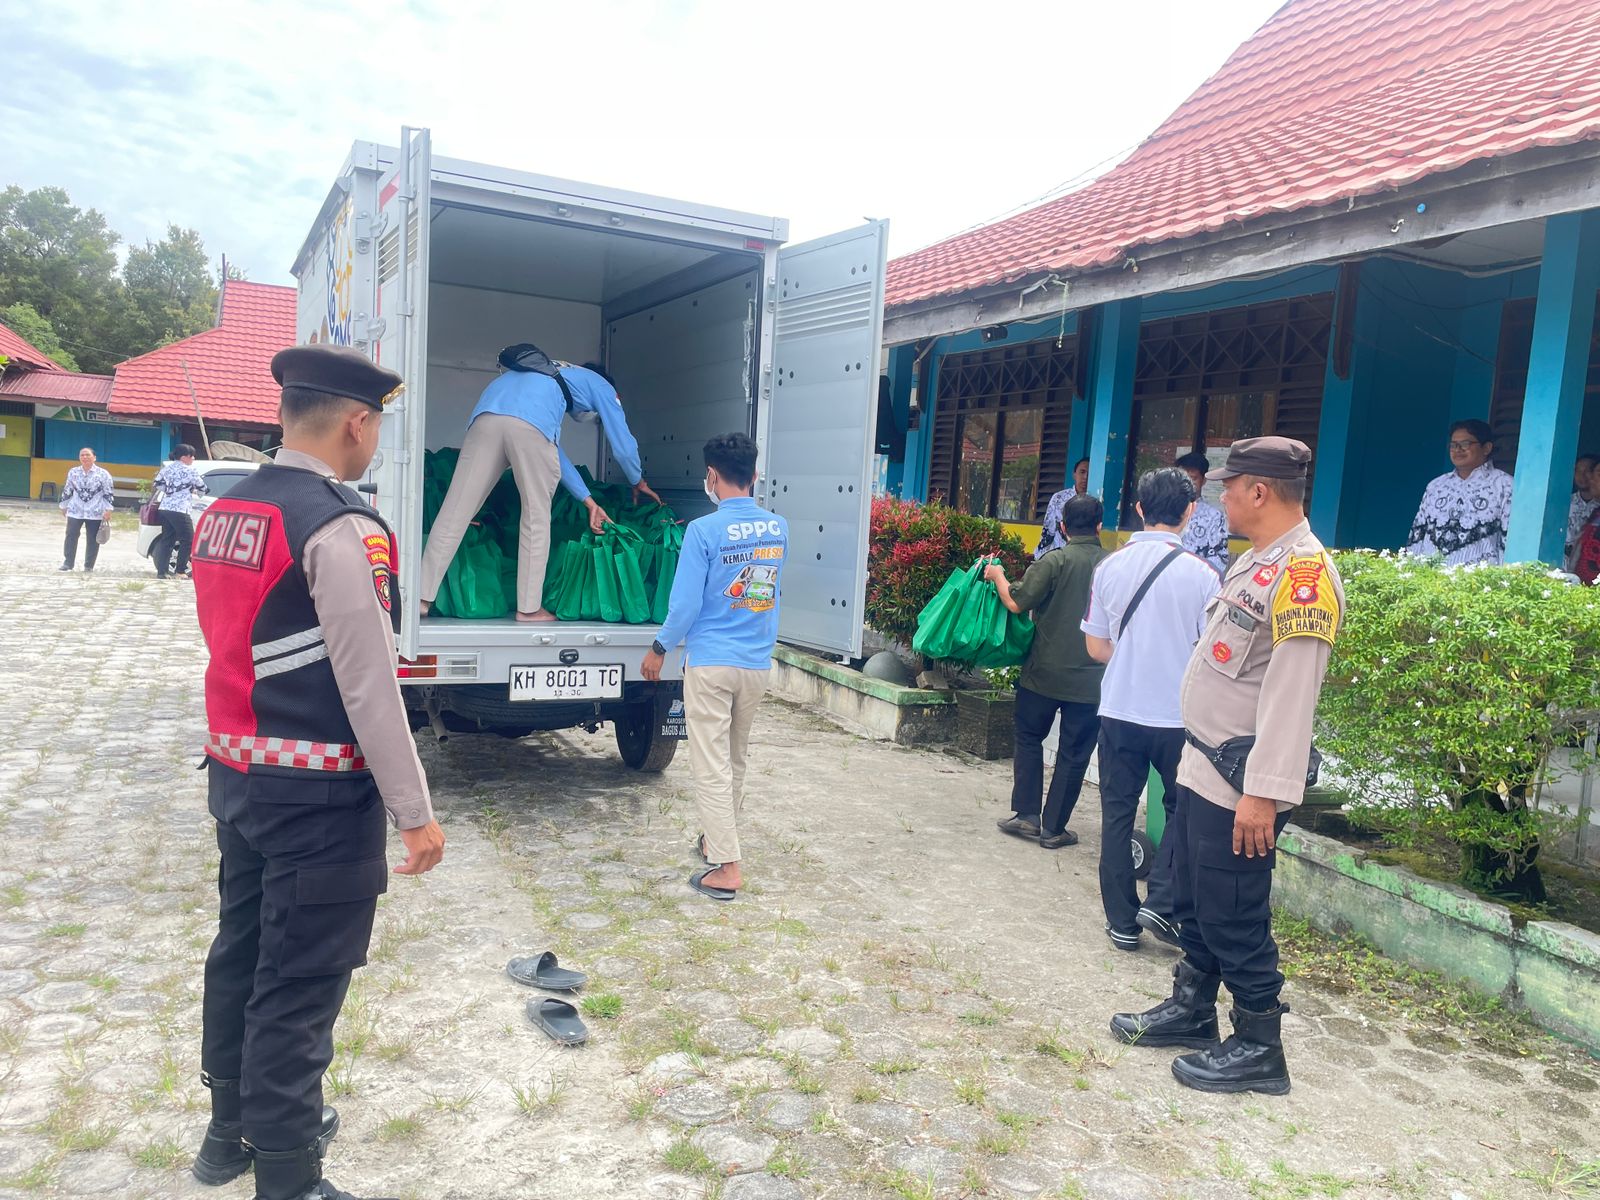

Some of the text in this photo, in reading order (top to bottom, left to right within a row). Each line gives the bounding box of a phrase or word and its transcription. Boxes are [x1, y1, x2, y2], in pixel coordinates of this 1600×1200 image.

[195, 514, 266, 565] POLISI
[727, 520, 781, 541] SPPG
[1237, 588, 1265, 615] POLRI
[1278, 620, 1294, 638] DESA
[514, 668, 619, 690] KH 8001 TC
[661, 725, 679, 736] BAGUS
[666, 717, 686, 725] KAROSER
